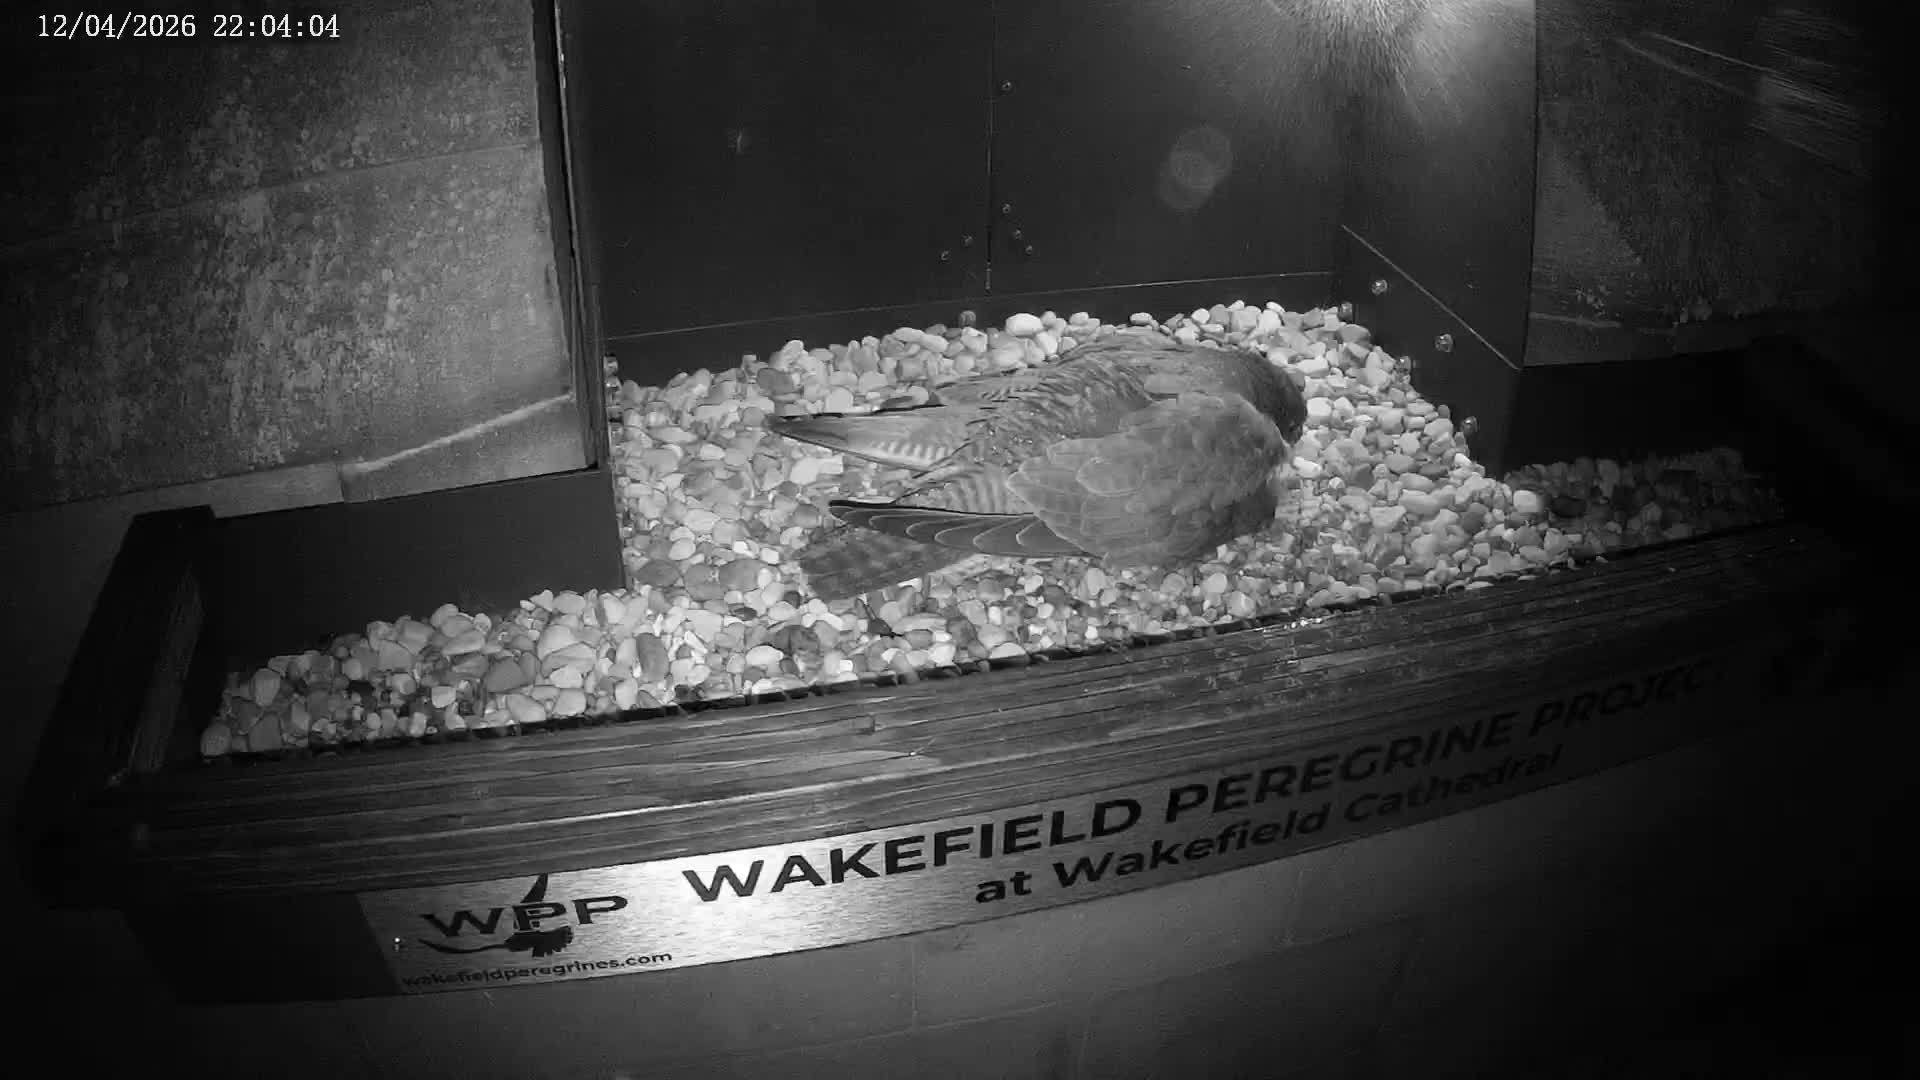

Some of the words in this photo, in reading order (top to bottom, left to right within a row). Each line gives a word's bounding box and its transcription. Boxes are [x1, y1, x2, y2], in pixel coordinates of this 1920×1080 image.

[682, 798, 1142, 902] WAKEFIELD
[1165, 711, 1520, 822] PEREGRINE
[1527, 657, 1724, 737] PROJEC
[975, 871, 1032, 903] at
[1052, 802, 1331, 888] Wakefield
[1344, 743, 1563, 822] Cathedral
[420, 895, 628, 937] WPP
[401, 951, 673, 988] wakefieldperegrines.com
